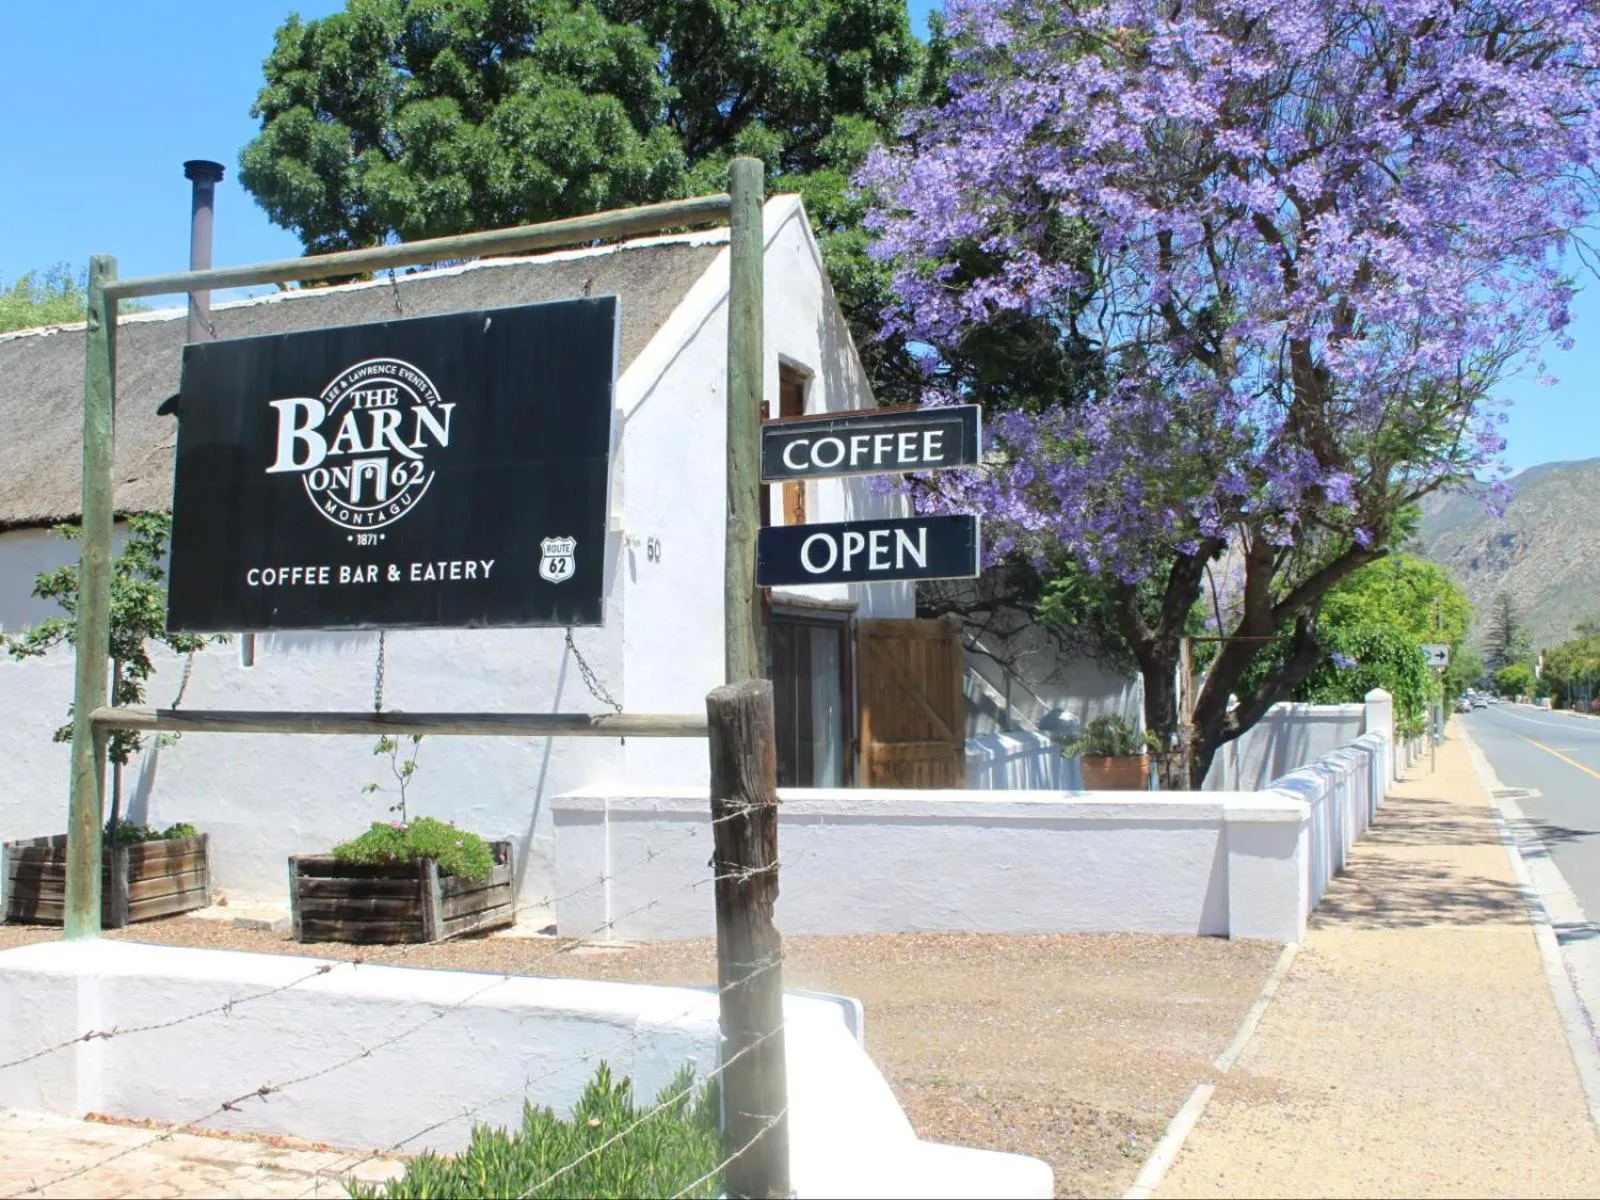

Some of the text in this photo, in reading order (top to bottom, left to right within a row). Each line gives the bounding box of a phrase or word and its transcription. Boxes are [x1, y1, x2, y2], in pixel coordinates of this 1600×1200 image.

[325, 386, 340, 403] LEE
[340, 380, 349, 389] &
[348, 365, 398, 383] LAWRENCE
[398, 368, 428, 392] EVENTS
[350, 387, 399, 409] THE
[265, 397, 456, 473] BARN
[783, 430, 945, 470] COFFEE
[308, 460, 425, 490] ON 62
[324, 492, 412, 525] MONTAGU
[356, 533, 378, 546] 1871
[547, 543, 571, 554] ROUTE
[800, 527, 928, 574] OPEN
[246, 559, 495, 586] COFFEE BAR & EATERY
[549, 558, 566, 573] 62
